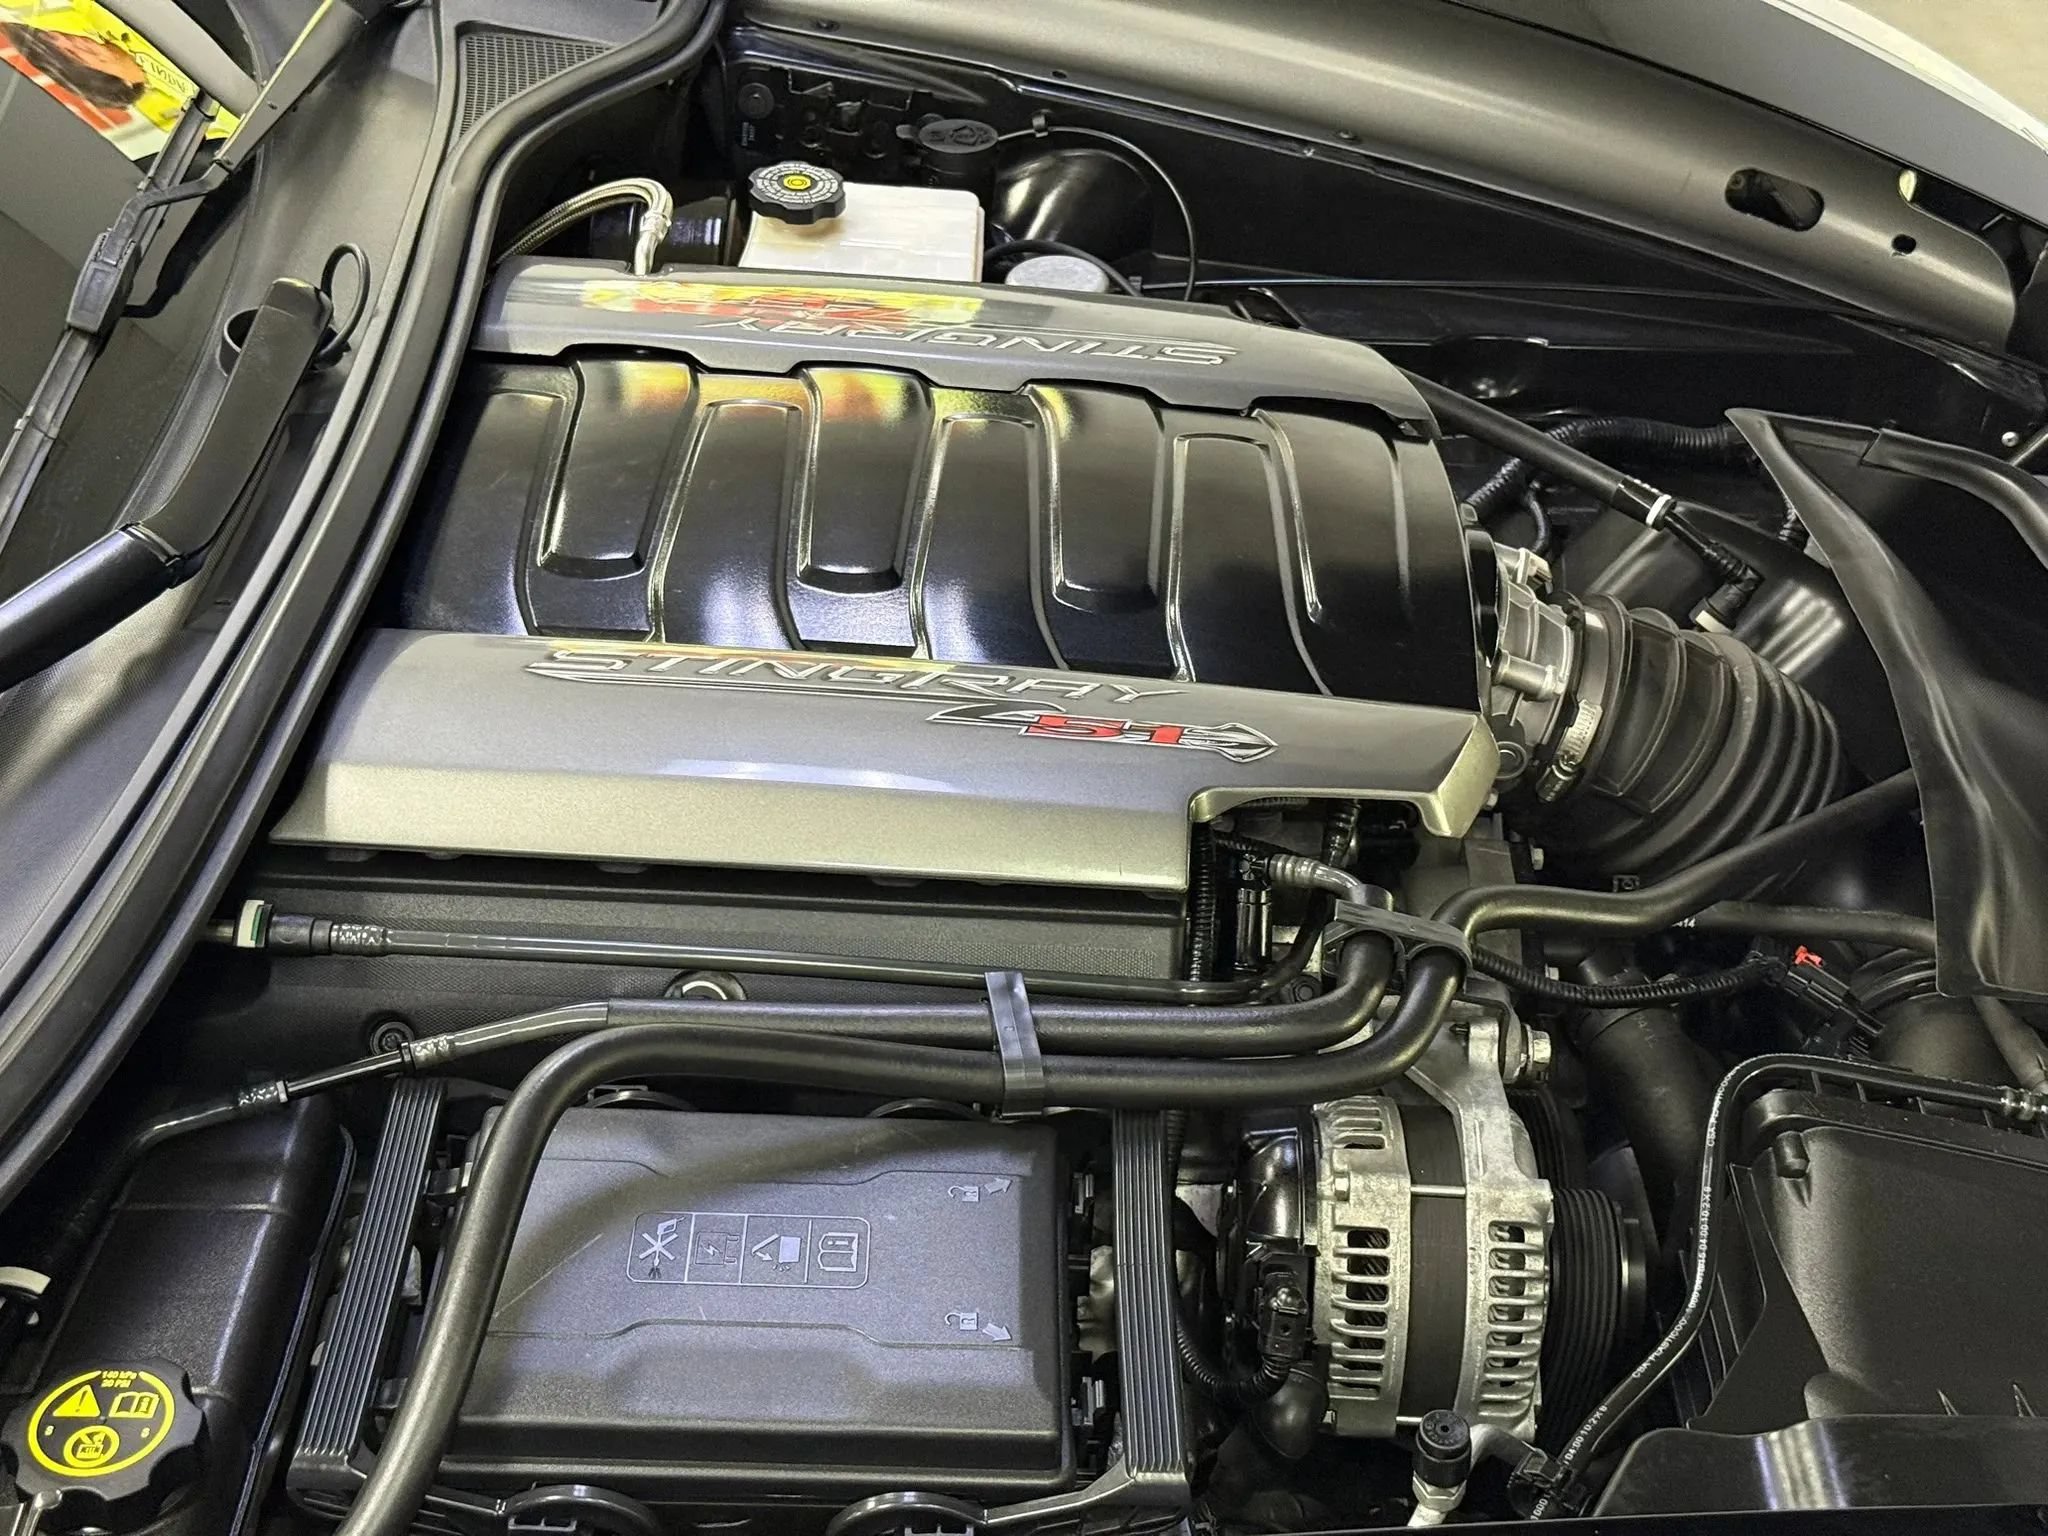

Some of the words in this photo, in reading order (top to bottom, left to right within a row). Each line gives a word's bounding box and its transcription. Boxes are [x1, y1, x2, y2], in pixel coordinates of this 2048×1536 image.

[697, 316, 1238, 365] STINGRAY
[530, 648, 1189, 704] STINGRAY
[925, 699, 1185, 747] Z51
